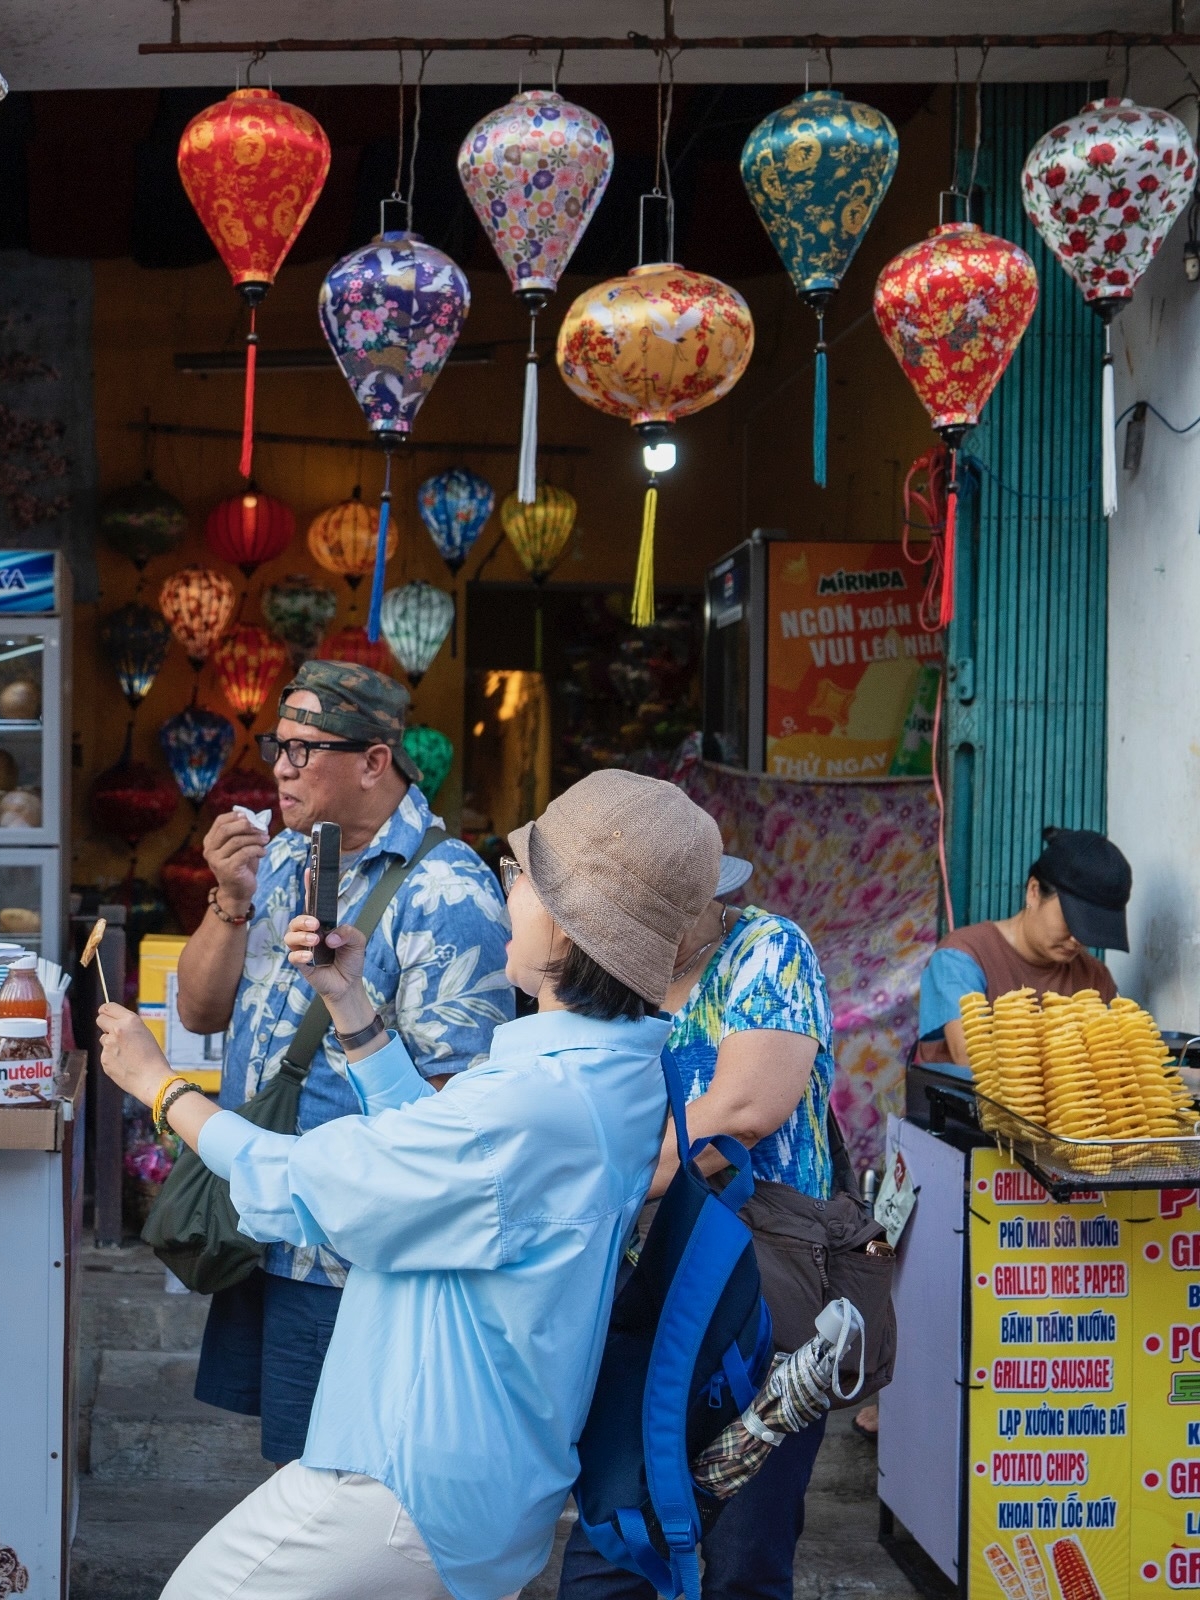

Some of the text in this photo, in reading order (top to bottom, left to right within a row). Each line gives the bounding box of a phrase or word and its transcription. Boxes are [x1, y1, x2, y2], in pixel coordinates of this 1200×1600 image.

[779, 603, 855, 640] NGON
[809, 636, 856, 668] VUI
[825, 751, 889, 776] NGAY
[999, 1214, 1119, 1248] PHÔ MAI SỮA NƯỚNG
[994, 1263, 1126, 1296] GRILLED RICE PAPER
[1001, 1309, 1116, 1344] BÁNH TRÁNG NƯỚNG
[994, 1358, 1110, 1389] GRILLED SAUSAGE
[999, 1408, 1022, 1441] LẠP
[1067, 1403, 1106, 1436] NƯỚNG
[1109, 1403, 1127, 1435] ĐÁ
[992, 1452, 1086, 1482] POTATO CHIPS
[998, 1492, 1117, 1529] KHOAI TÂY LỐC XOÁY
